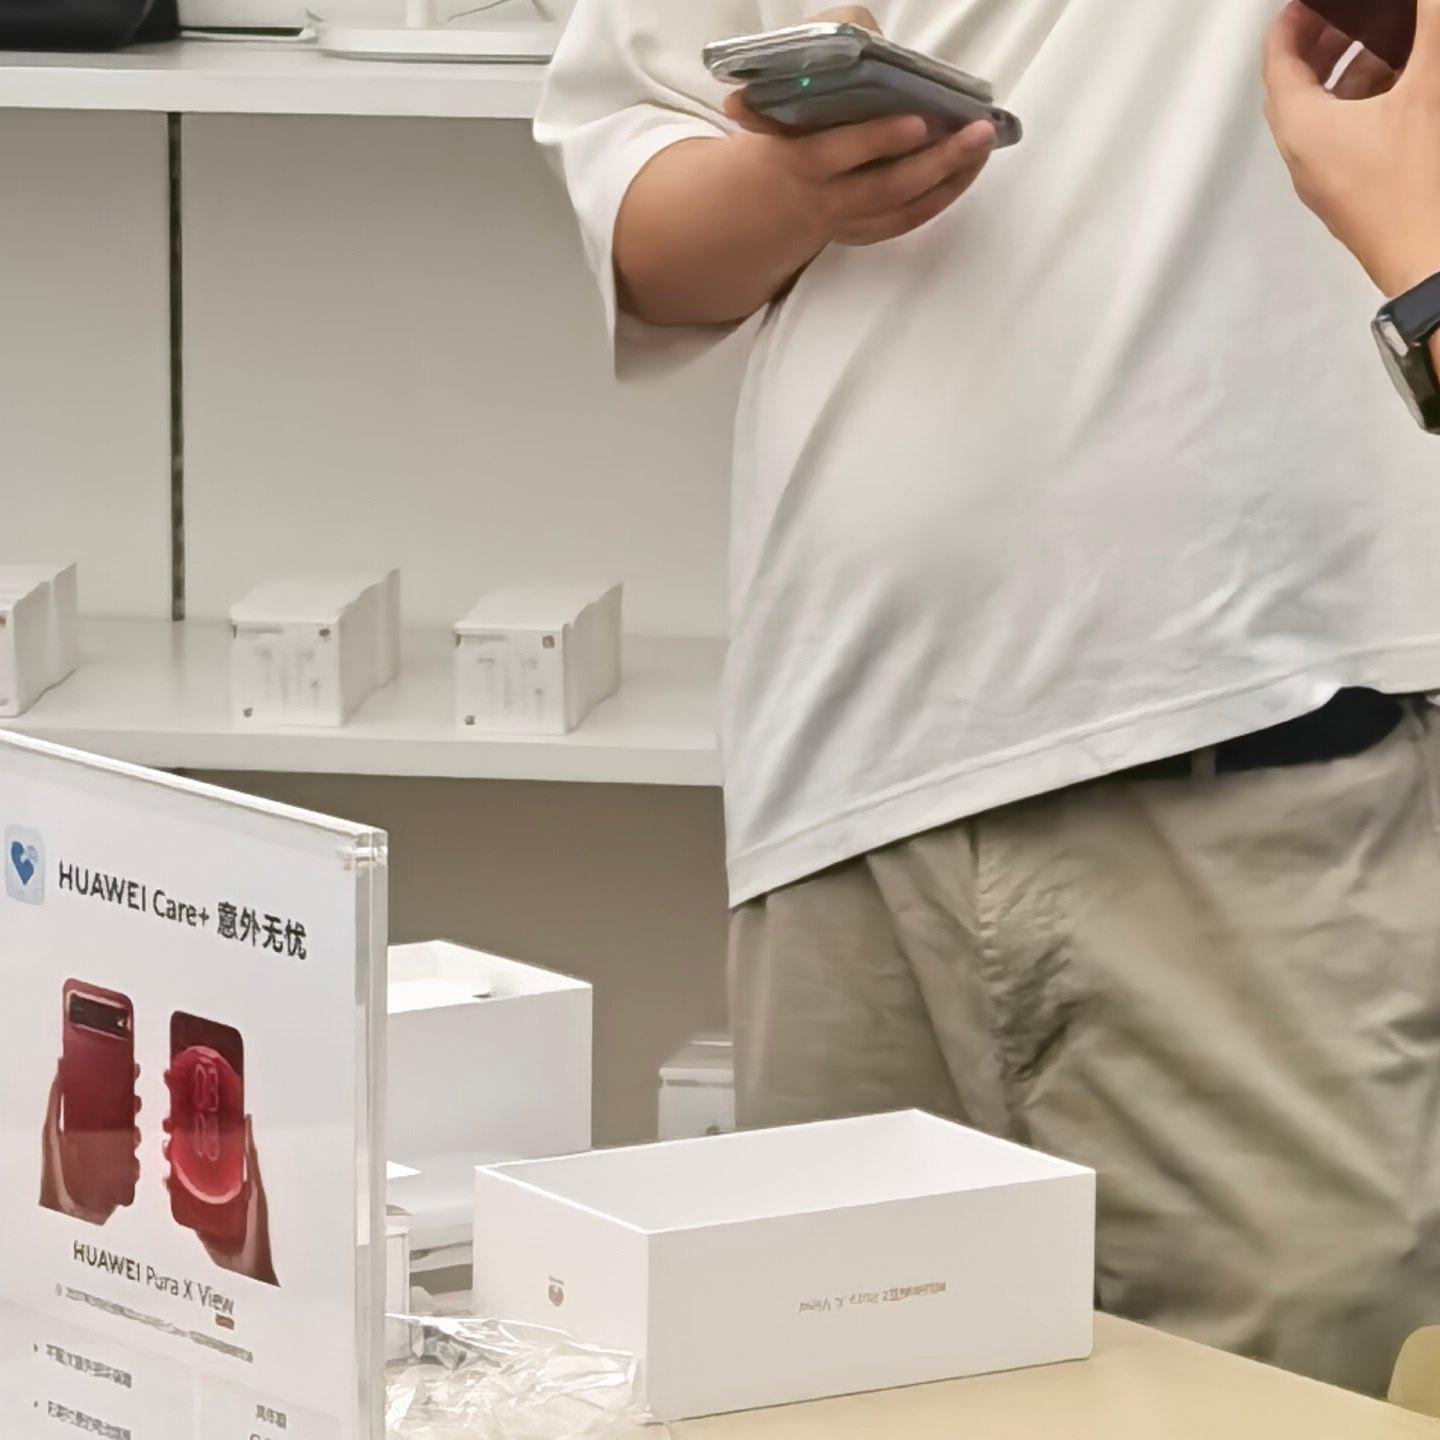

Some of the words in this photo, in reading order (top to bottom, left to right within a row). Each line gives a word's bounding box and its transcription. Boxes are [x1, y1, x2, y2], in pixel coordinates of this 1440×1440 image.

[58, 860, 147, 912] HUAWEI
[153, 889, 210, 927] Care+
[217, 901, 307, 960] 意外无忧
[73, 1239, 140, 1283] HUAWEI
[146, 1264, 179, 1296] Pura
[182, 1278, 194, 1301] X
[198, 1282, 234, 1315] View
